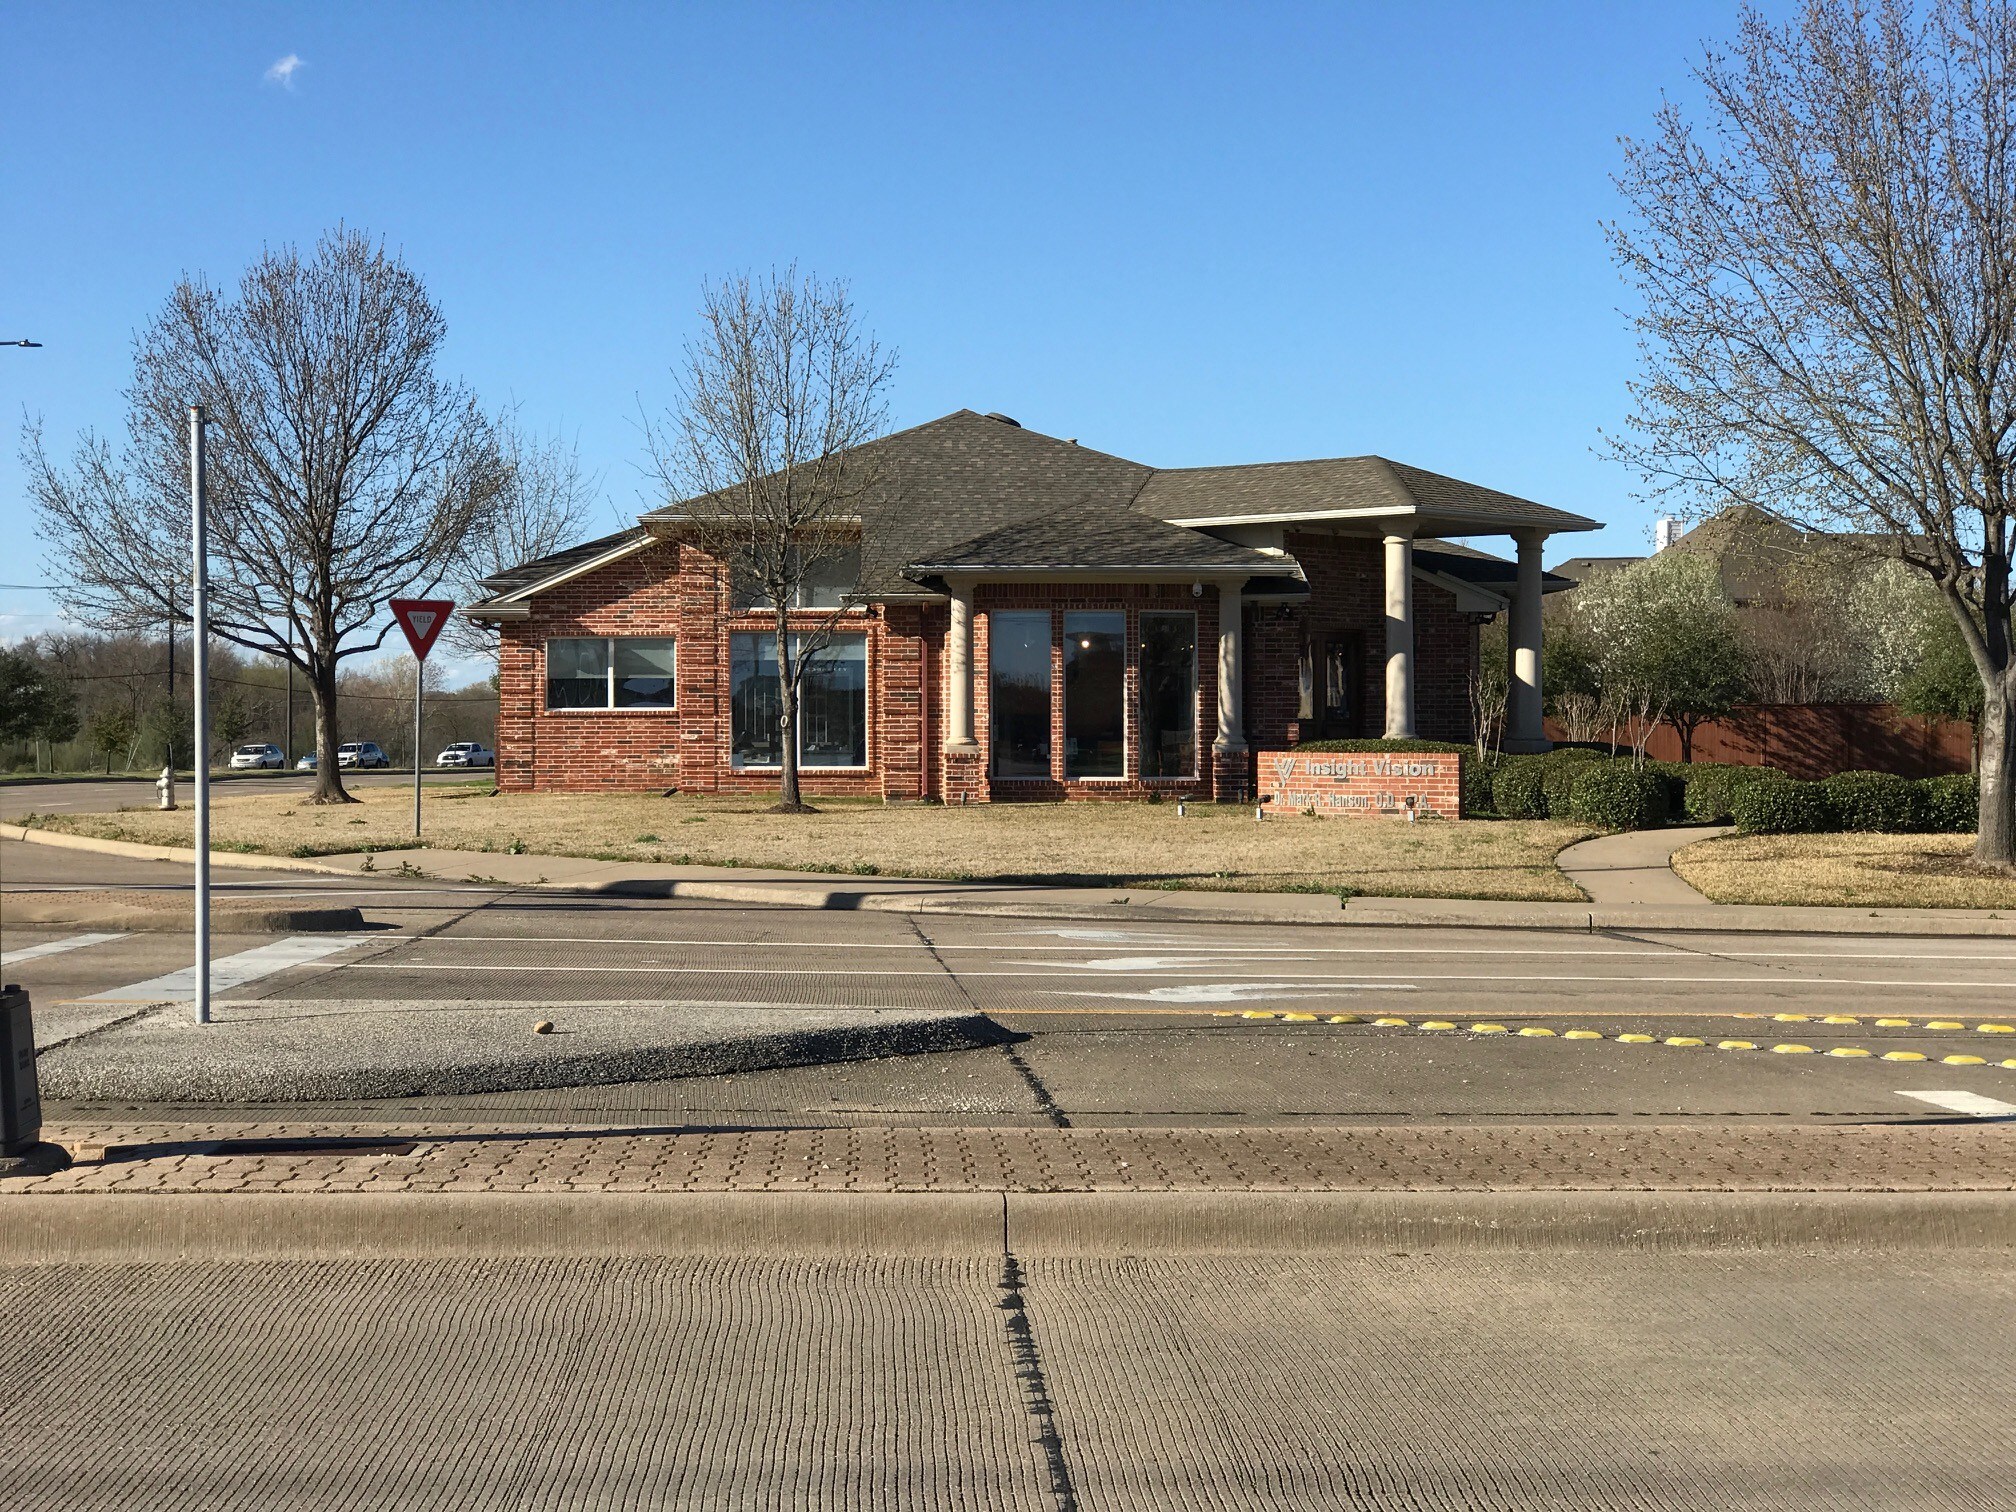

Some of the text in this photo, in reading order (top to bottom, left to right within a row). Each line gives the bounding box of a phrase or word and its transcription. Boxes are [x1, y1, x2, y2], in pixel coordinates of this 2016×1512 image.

[1305, 758, 1435, 779] Insight Vision
[1287, 791, 1310, 806] Mark
[1313, 792, 1325, 807] R.
